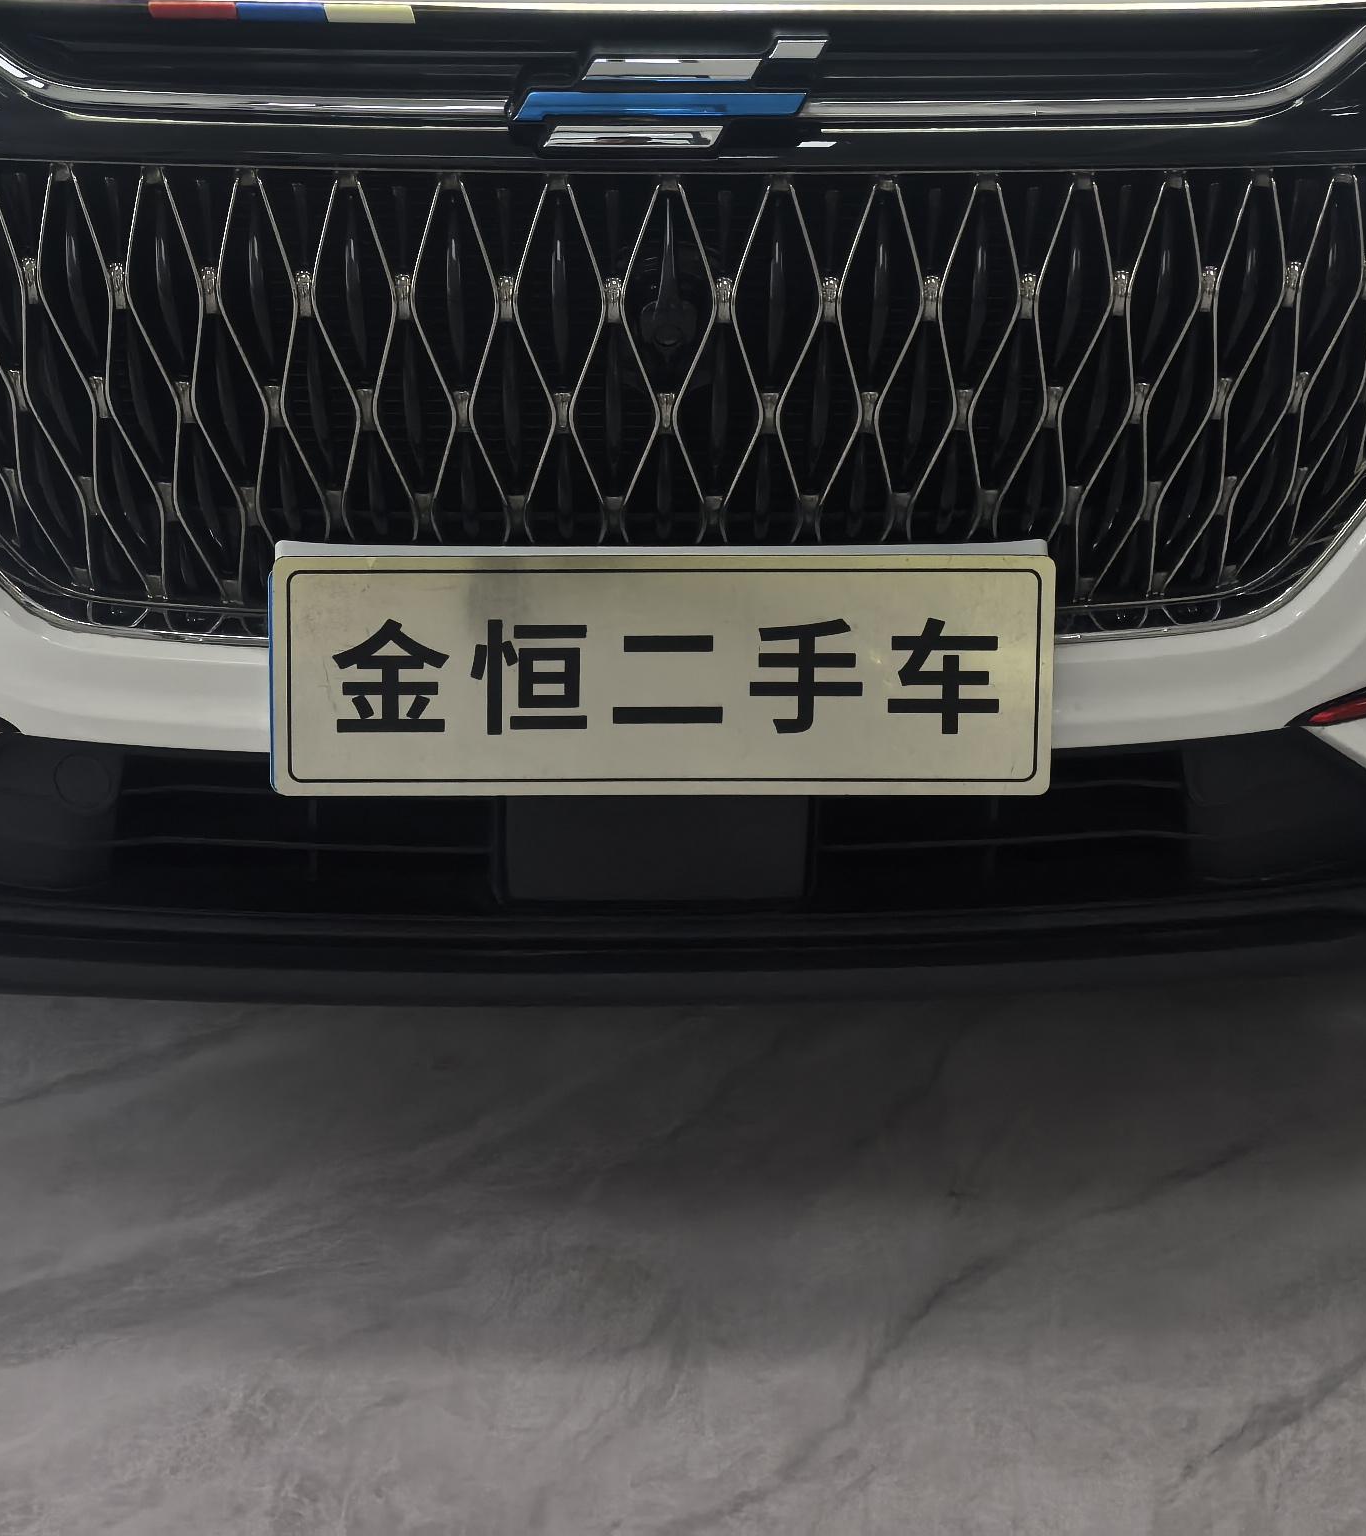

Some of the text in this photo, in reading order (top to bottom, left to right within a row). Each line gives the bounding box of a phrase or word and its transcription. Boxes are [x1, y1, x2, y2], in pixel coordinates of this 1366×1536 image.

[332, 618, 1000, 735] 金恒二手车
